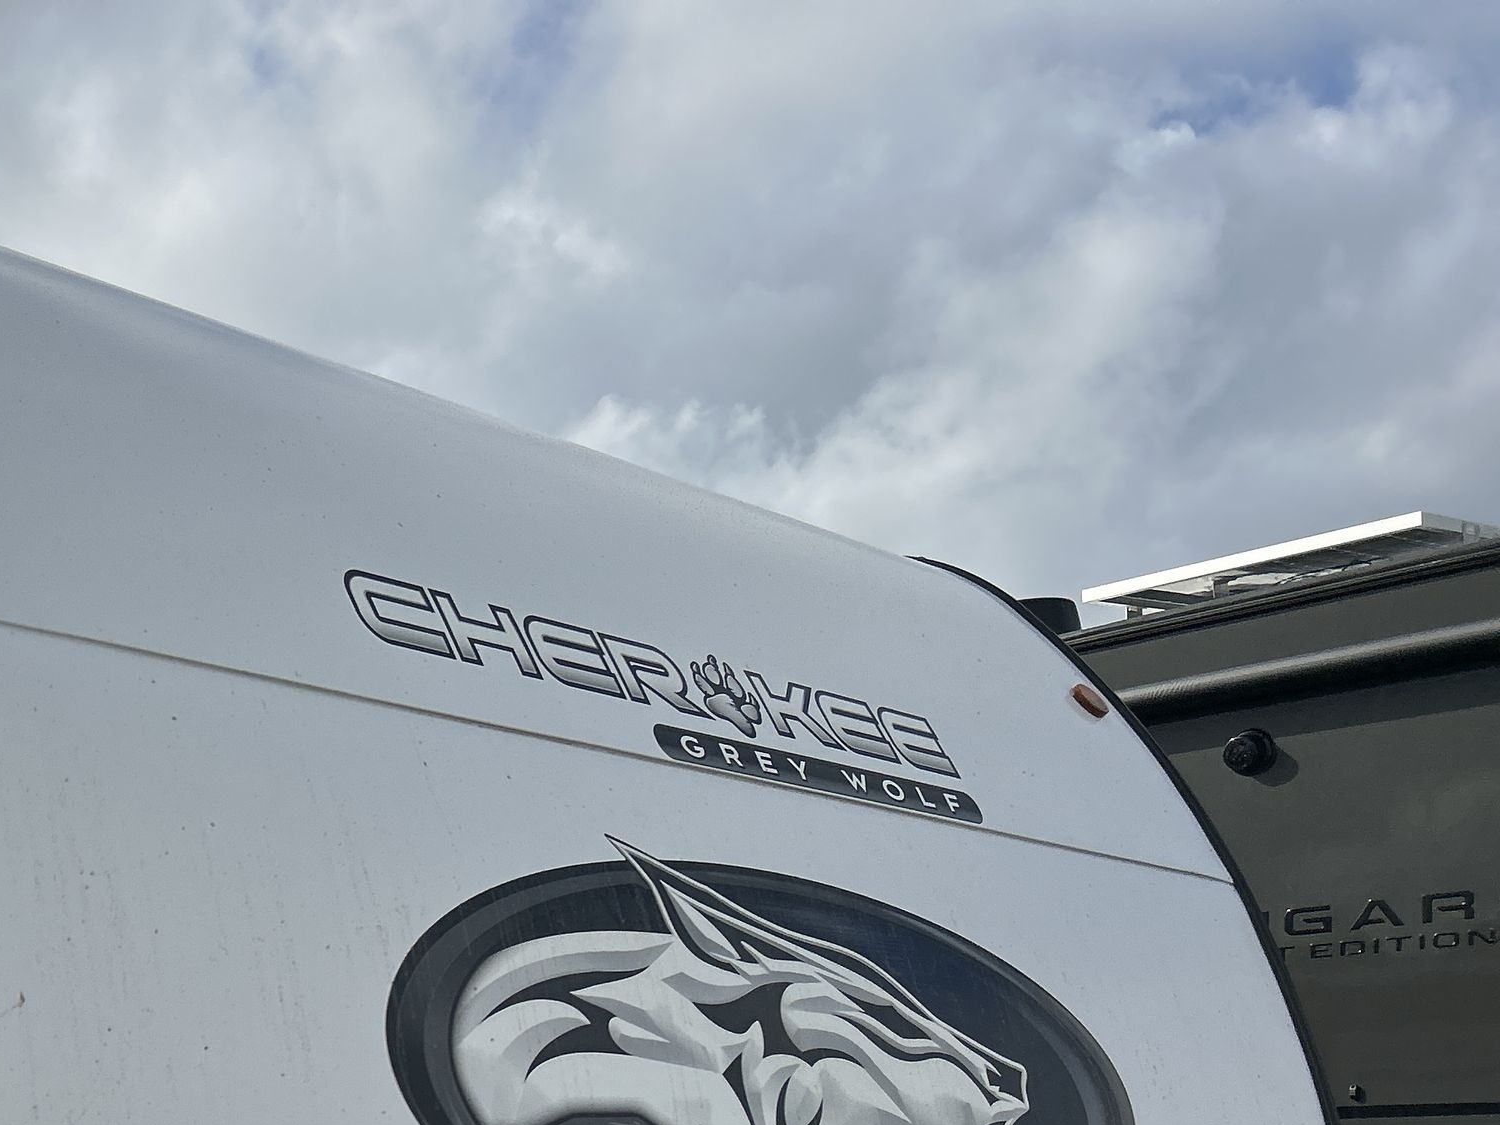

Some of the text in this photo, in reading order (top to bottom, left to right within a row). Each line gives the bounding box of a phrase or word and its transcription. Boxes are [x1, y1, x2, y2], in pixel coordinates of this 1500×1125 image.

[680, 734, 961, 815] GREY WOLF
[1309, 927, 1500, 960] EDITION
